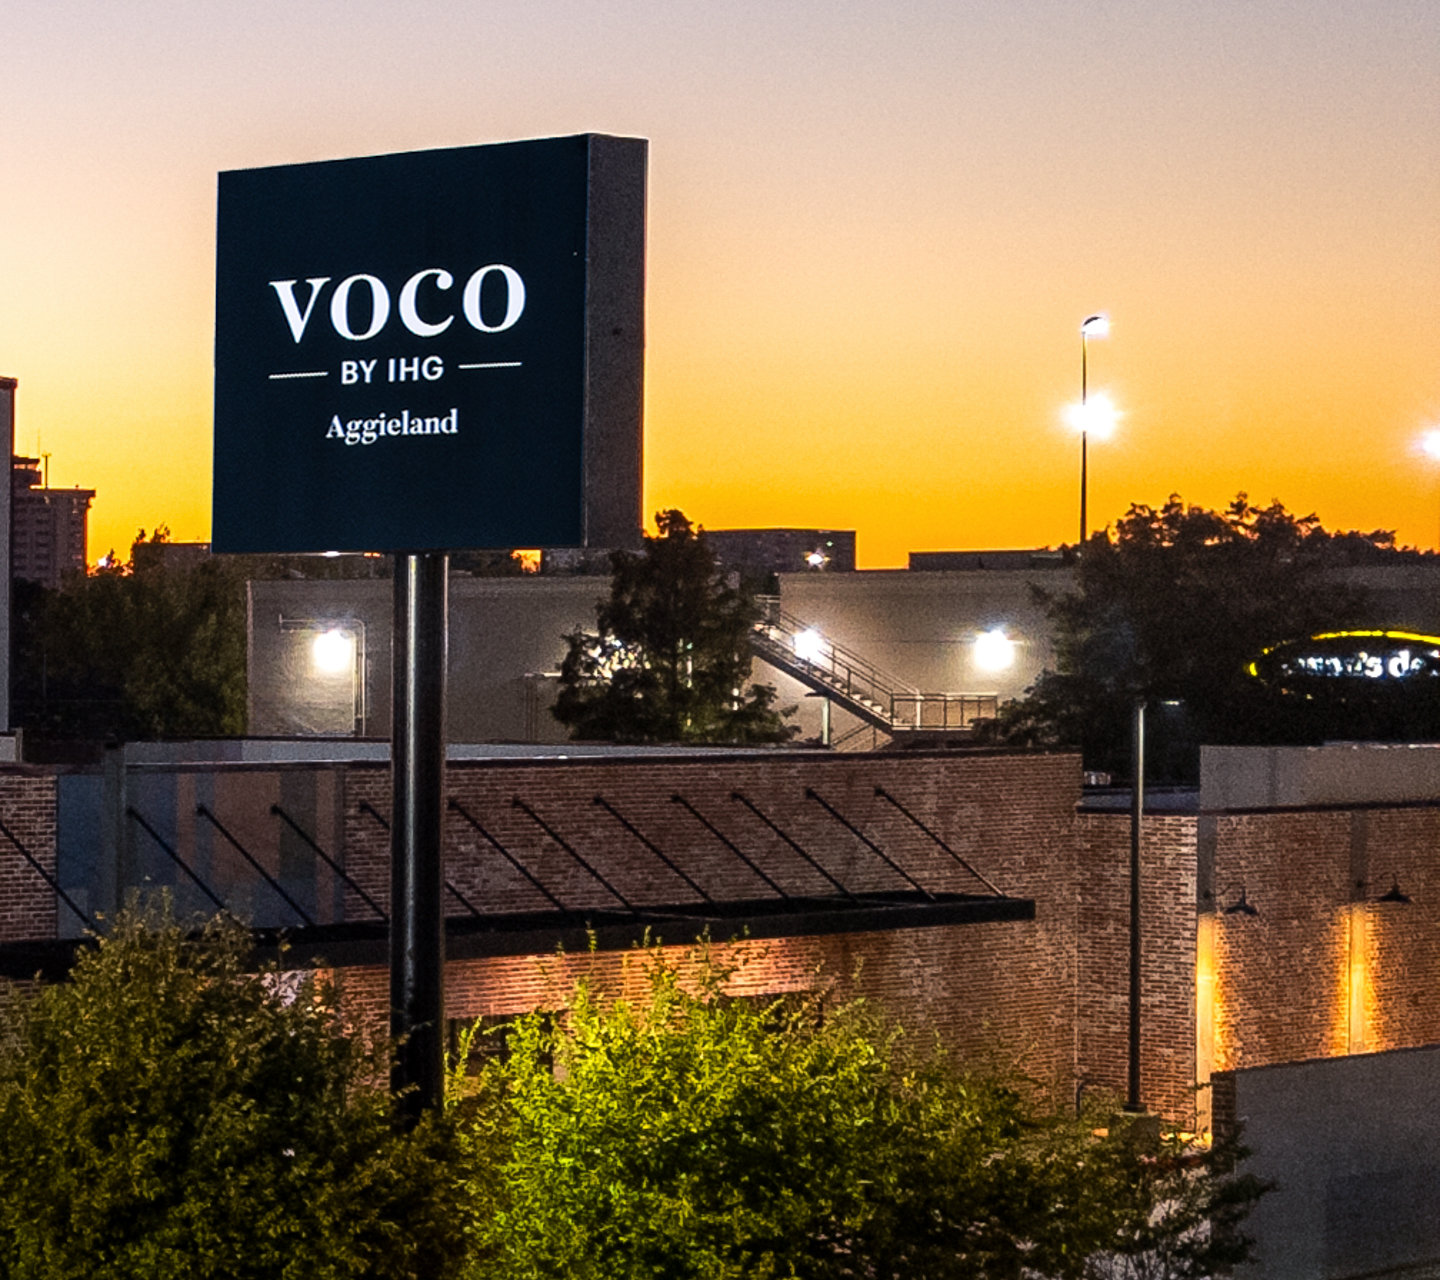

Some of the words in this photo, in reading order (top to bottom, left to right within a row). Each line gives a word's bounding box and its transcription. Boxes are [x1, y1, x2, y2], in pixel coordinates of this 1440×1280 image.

[341, 360, 377, 385] BY
[388, 356, 444, 383] IHG
[326, 408, 458, 446] Aggieland
